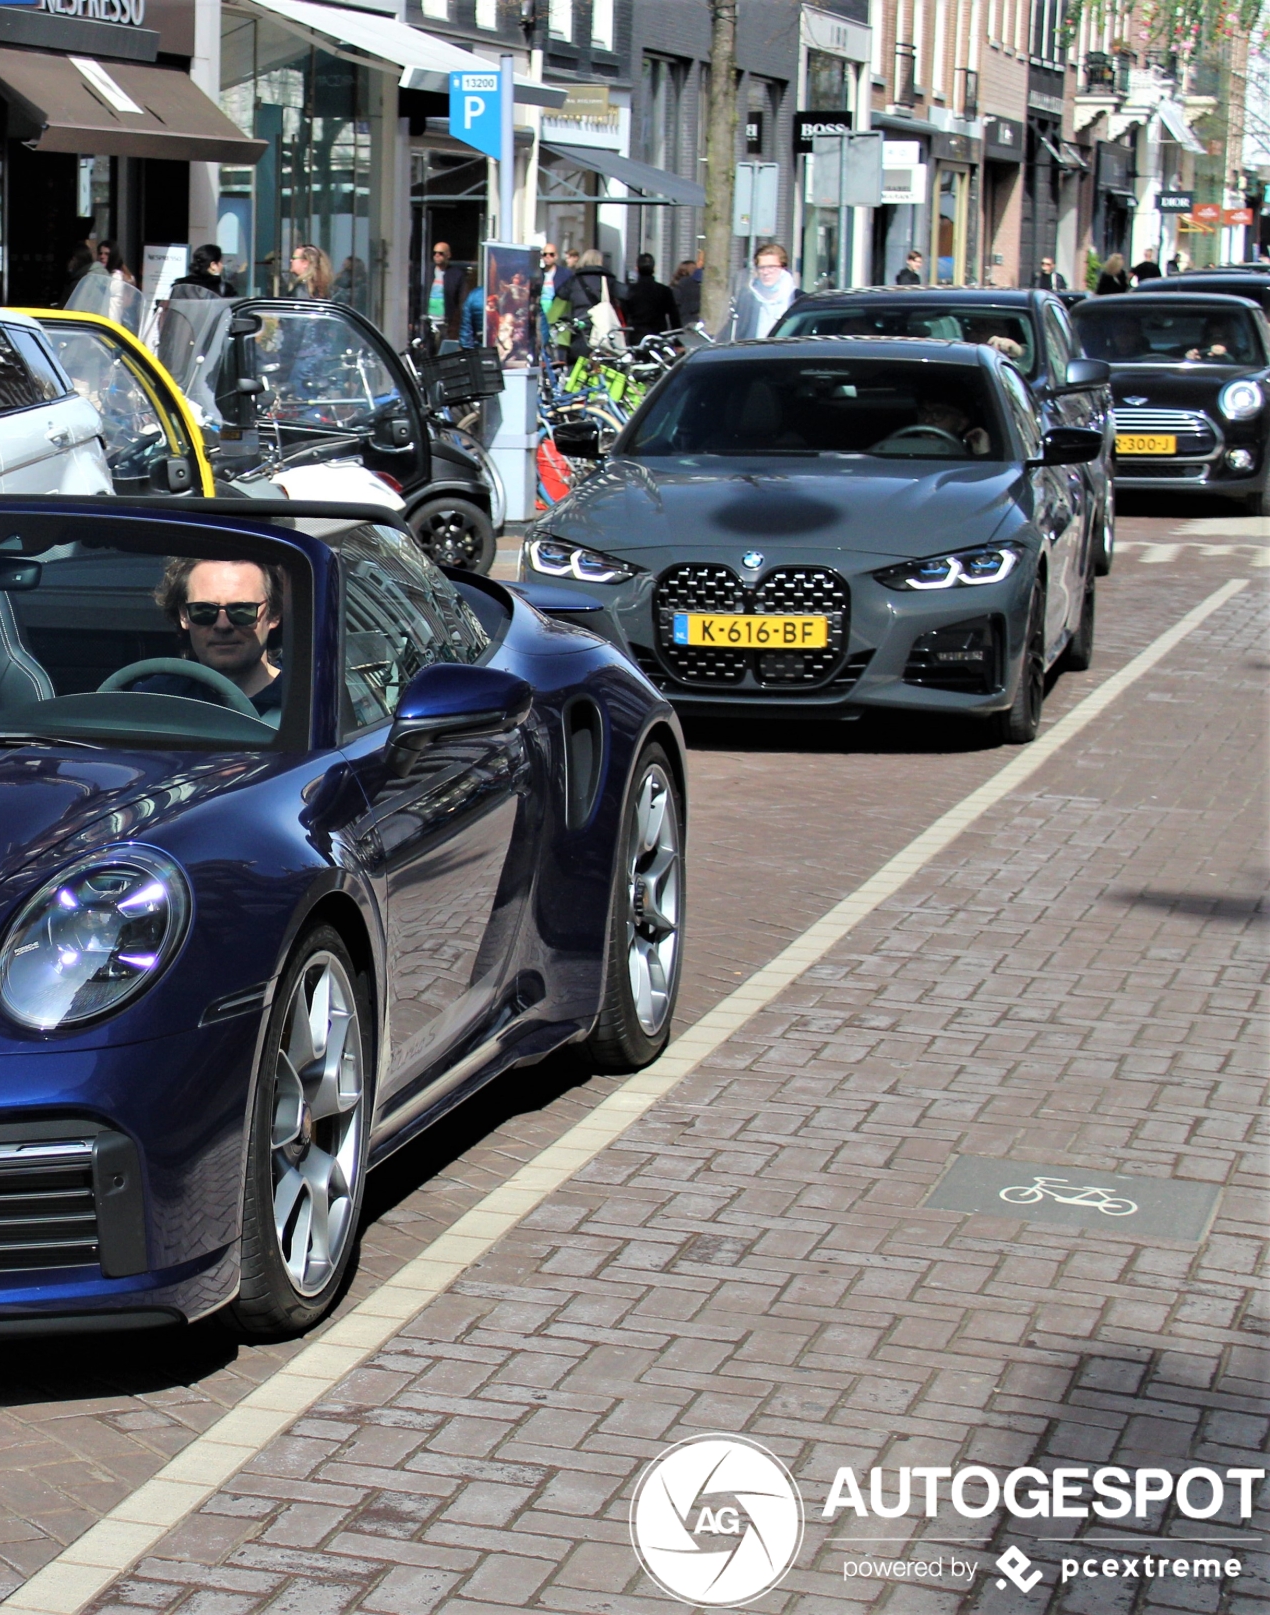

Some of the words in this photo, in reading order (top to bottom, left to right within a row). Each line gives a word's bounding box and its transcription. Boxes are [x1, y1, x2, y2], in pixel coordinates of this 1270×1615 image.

[465, 78, 495, 88] 13200
[464, 96, 486, 129] P
[801, 123, 847, 137] BOSS
[1161, 197, 1190, 207] DIOR
[702, 620, 813, 643] K-616-BF
